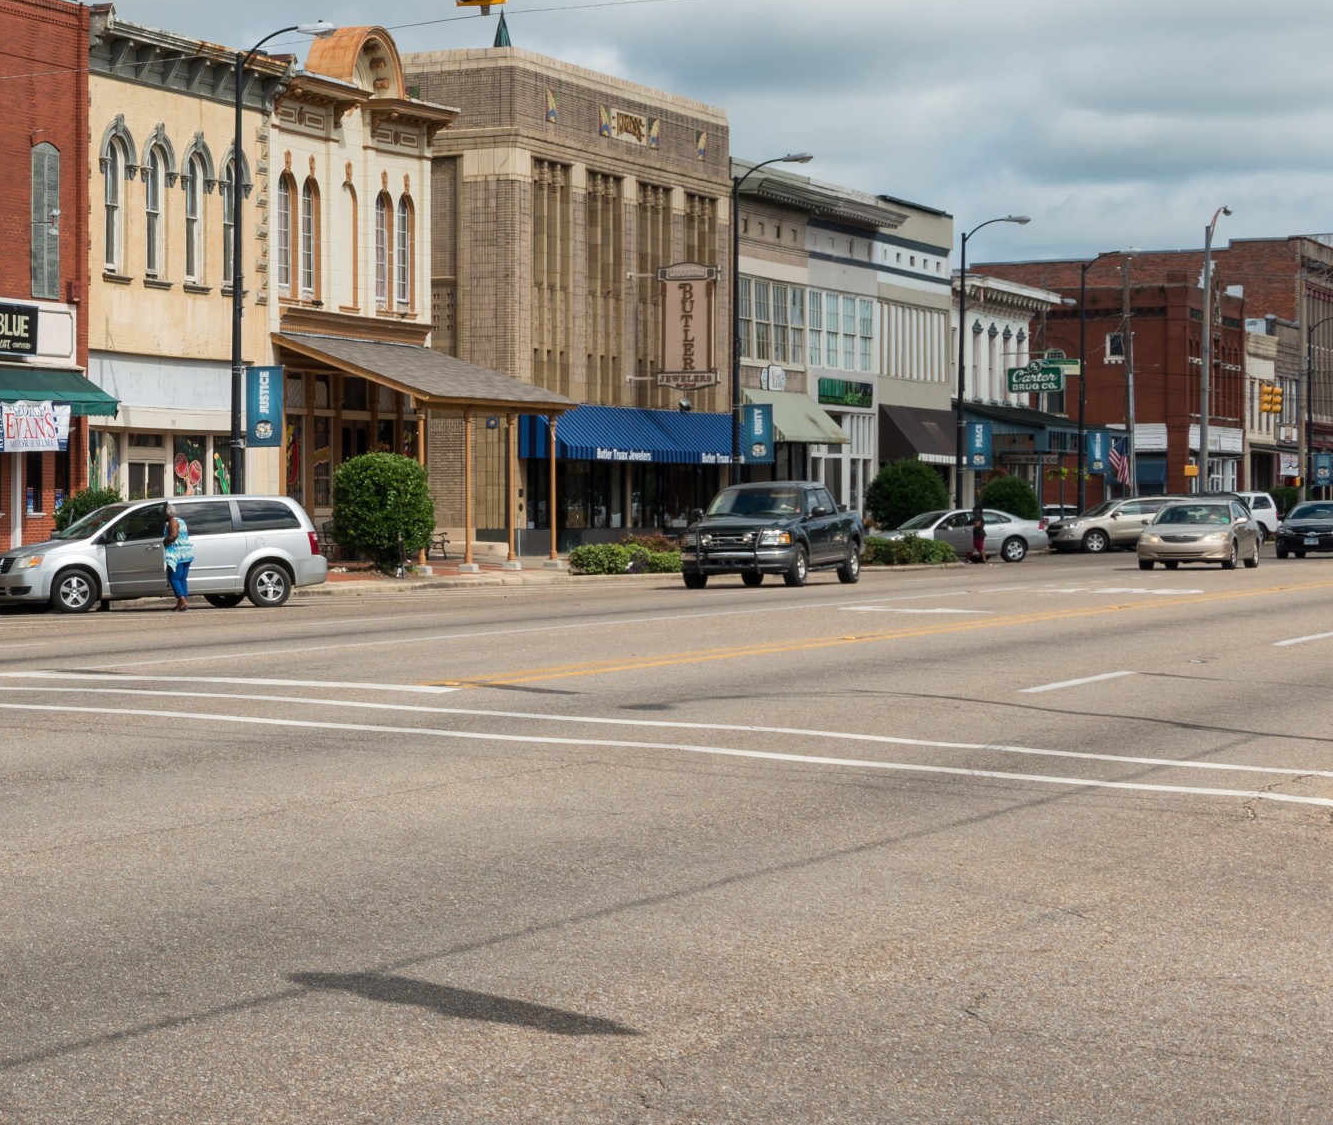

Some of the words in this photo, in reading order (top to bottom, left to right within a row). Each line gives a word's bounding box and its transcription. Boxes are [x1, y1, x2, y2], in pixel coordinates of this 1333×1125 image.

[678, 282, 695, 371] BUTLER
[659, 374, 712, 383] JEWELERS
[1012, 370, 1057, 383] Carter
[259, 371, 269, 414] JUSTICE
[5, 412, 55, 439] EVANS
[754, 408, 763, 435] UNITY
[36, 439, 54, 447] SELMA
[596, 448, 612, 459] Butler
[613, 449, 628, 460] Truax
[629, 449, 651, 461] Jewelers
[702, 452, 716, 464] Butler
